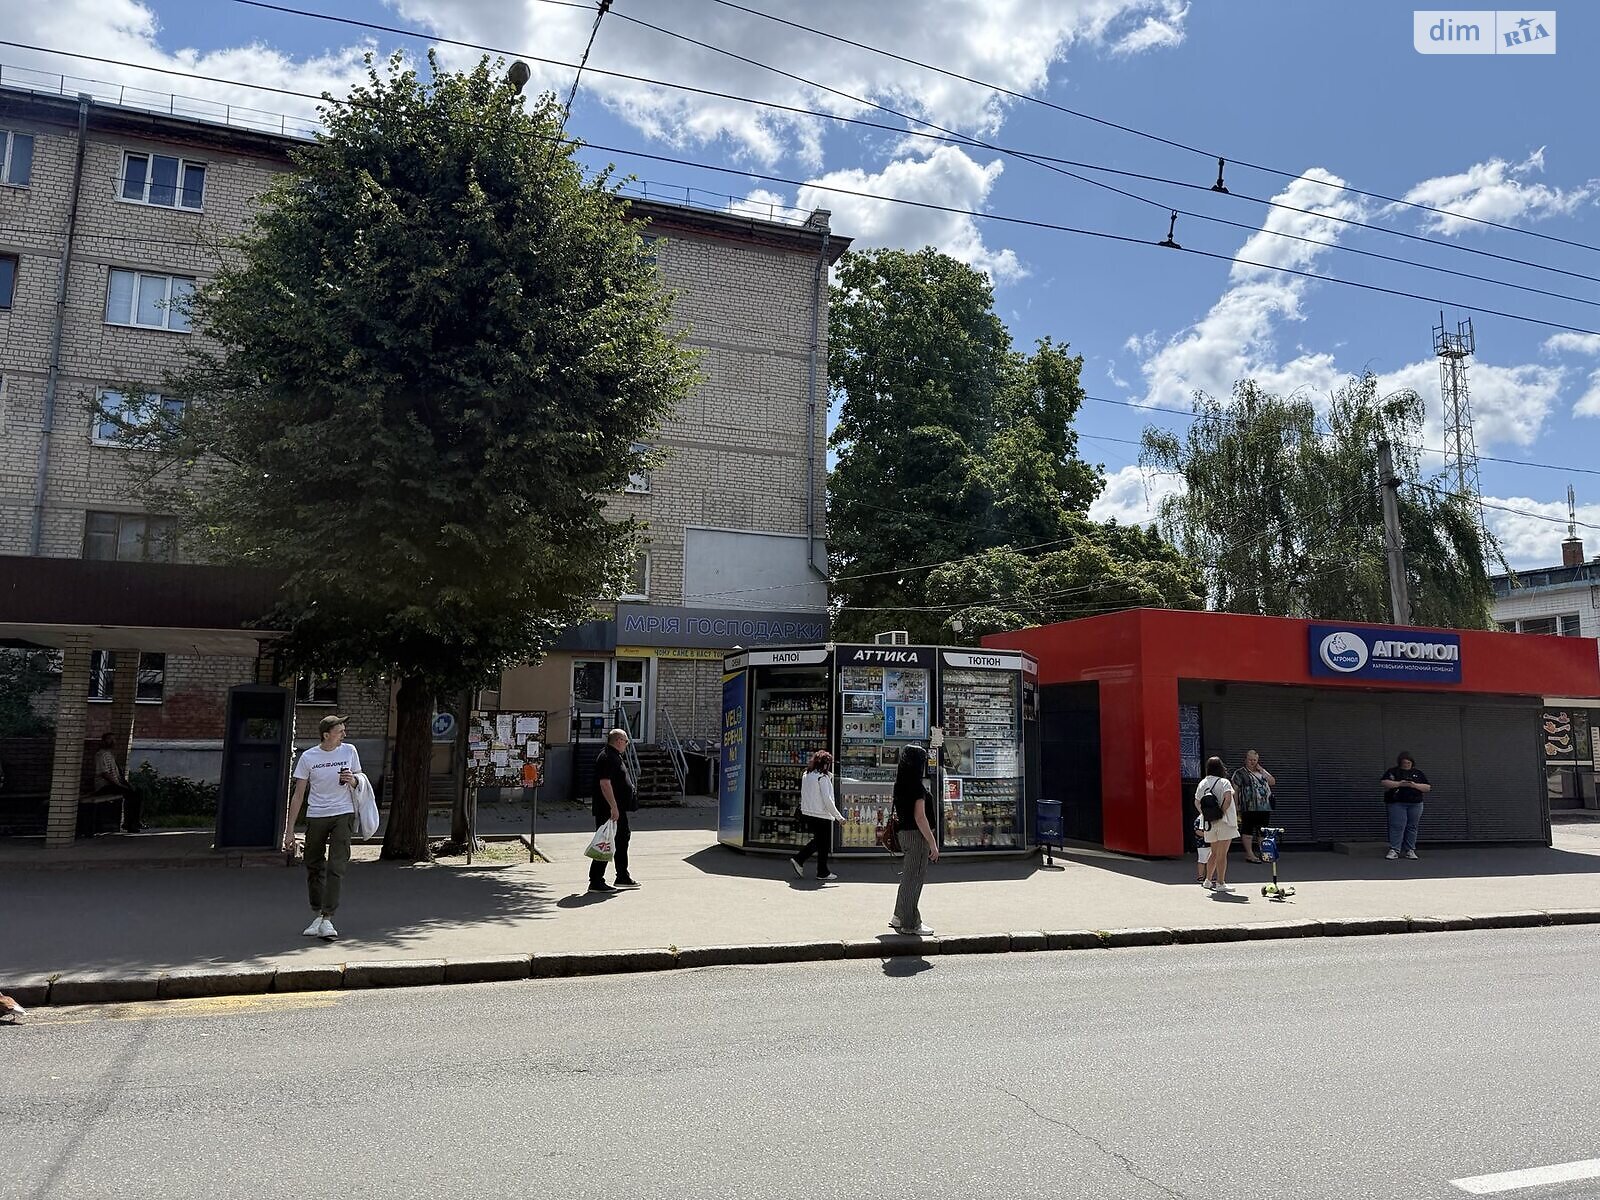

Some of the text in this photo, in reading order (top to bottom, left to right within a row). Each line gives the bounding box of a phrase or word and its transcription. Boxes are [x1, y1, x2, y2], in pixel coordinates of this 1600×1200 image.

[624, 614, 823, 641] МРІЯ ГОСПОДАРКИ
[772, 651, 801, 662] НАПОЇ
[853, 649, 919, 663] АТТИКА
[1371, 640, 1458, 661] АГРОМОЛ
[968, 656, 1001, 666] ТЮТЮН
